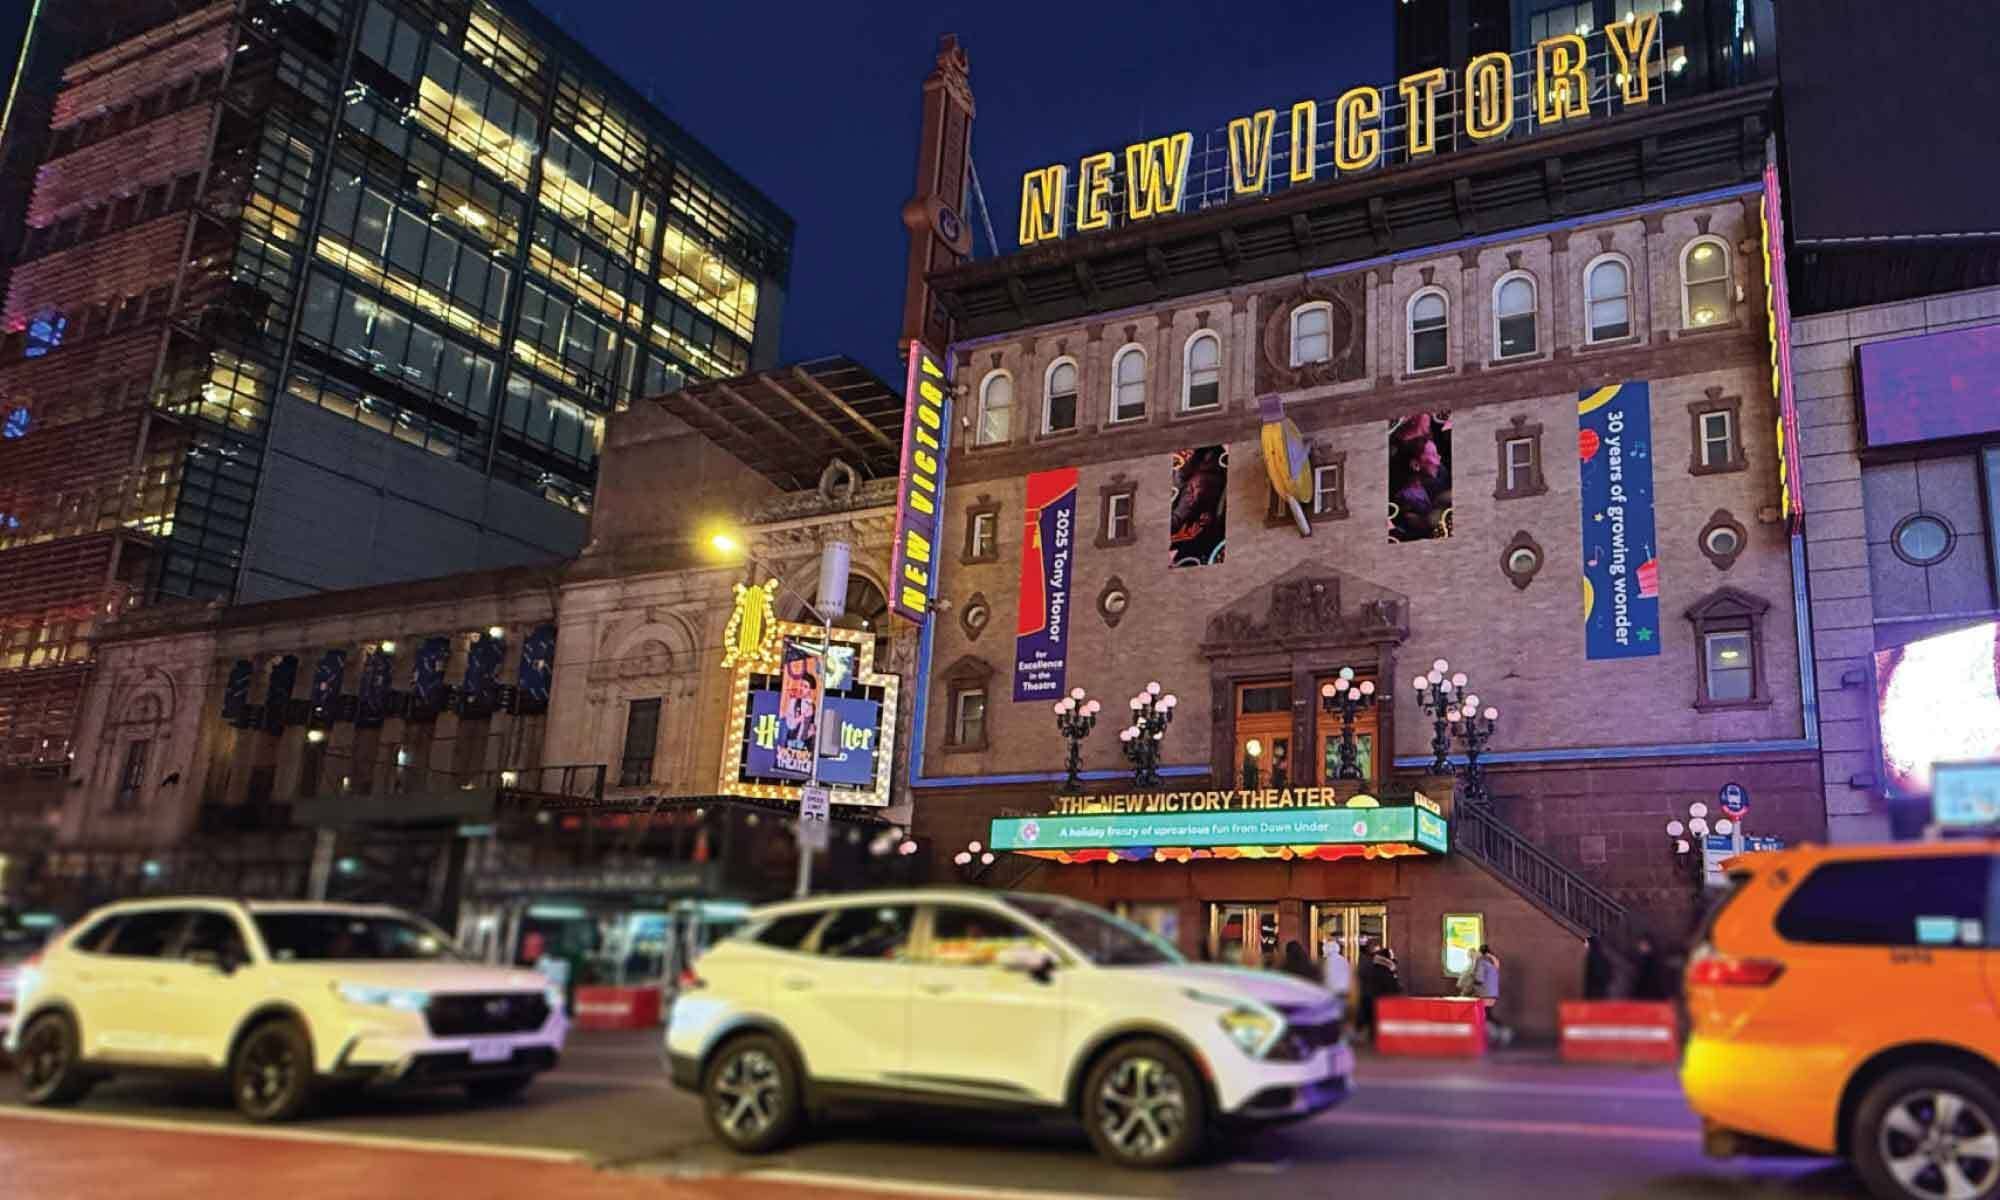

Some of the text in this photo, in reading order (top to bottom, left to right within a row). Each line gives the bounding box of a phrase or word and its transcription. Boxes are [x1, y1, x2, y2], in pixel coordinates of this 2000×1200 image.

[1019, 132, 1194, 245] NEW
[1228, 14, 1661, 194] VICTORY
[902, 355, 944, 613] NEW VICTORY
[1605, 411, 1632, 645] 30 years of growing wonder
[1049, 509, 1069, 642] 2025 Tony Honor
[1018, 660, 1063, 671] Excellence
[1059, 797, 1097, 814] THE
[1100, 795, 1145, 813] NEW
[1145, 791, 1233, 812] VICTORY
[1238, 787, 1336, 809] THEATER
[1069, 826, 1105, 839] holiday
[1141, 825, 1153, 836] of
[1153, 824, 1210, 837] uproarious
[1212, 823, 1230, 833] fun
[1232, 823, 1257, 833] from
[1260, 822, 1292, 833] Down
[1294, 821, 1328, 832] Under
